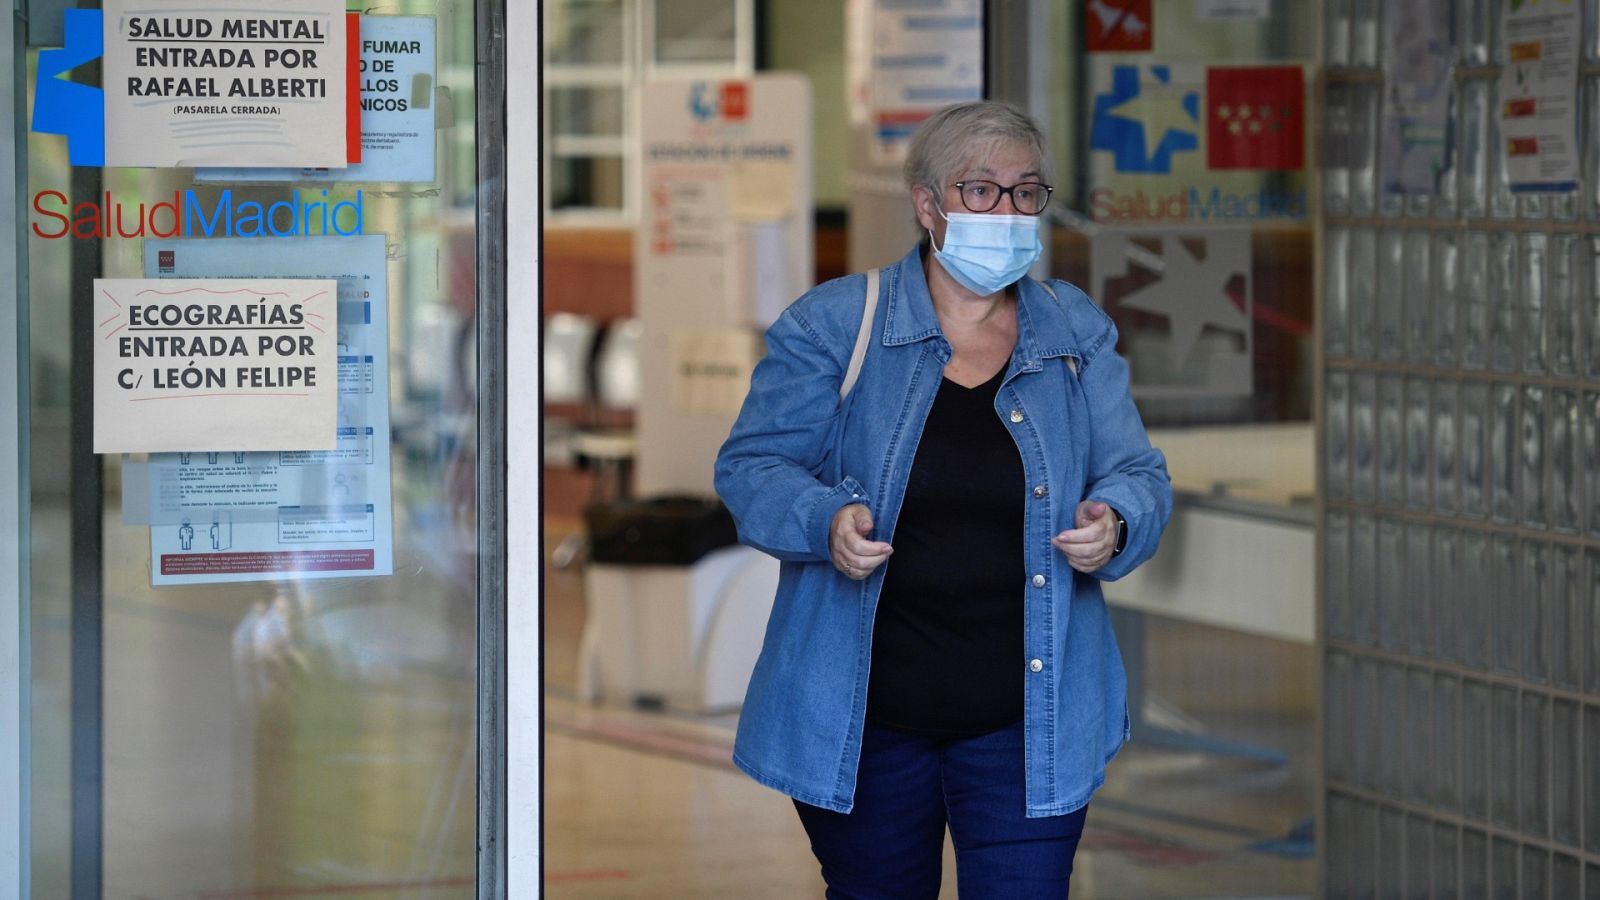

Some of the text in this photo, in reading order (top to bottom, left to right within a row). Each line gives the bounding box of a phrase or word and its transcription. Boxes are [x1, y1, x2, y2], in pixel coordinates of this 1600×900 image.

[128, 17, 325, 39] SALUD MENTAL
[136, 47, 318, 69] ENTRADA POR
[363, 41, 421, 54] FUMAR
[372, 60, 394, 73] DE
[127, 77, 326, 98] RAFAEL ALBERTI
[360, 79, 399, 92] LOS
[173, 105, 281, 115] (PASARELA CERRADA)
[360, 98, 408, 112] NICOS
[31, 189, 363, 239] SaludMadrid
[1089, 186, 1307, 224] SaludMadrid
[128, 297, 304, 326] ECOGRAFÍAS
[119, 335, 315, 358] ENTRADA POR
[117, 368, 143, 390] C/
[153, 361, 226, 389] LEÓN
[236, 366, 316, 388] FELIPE
